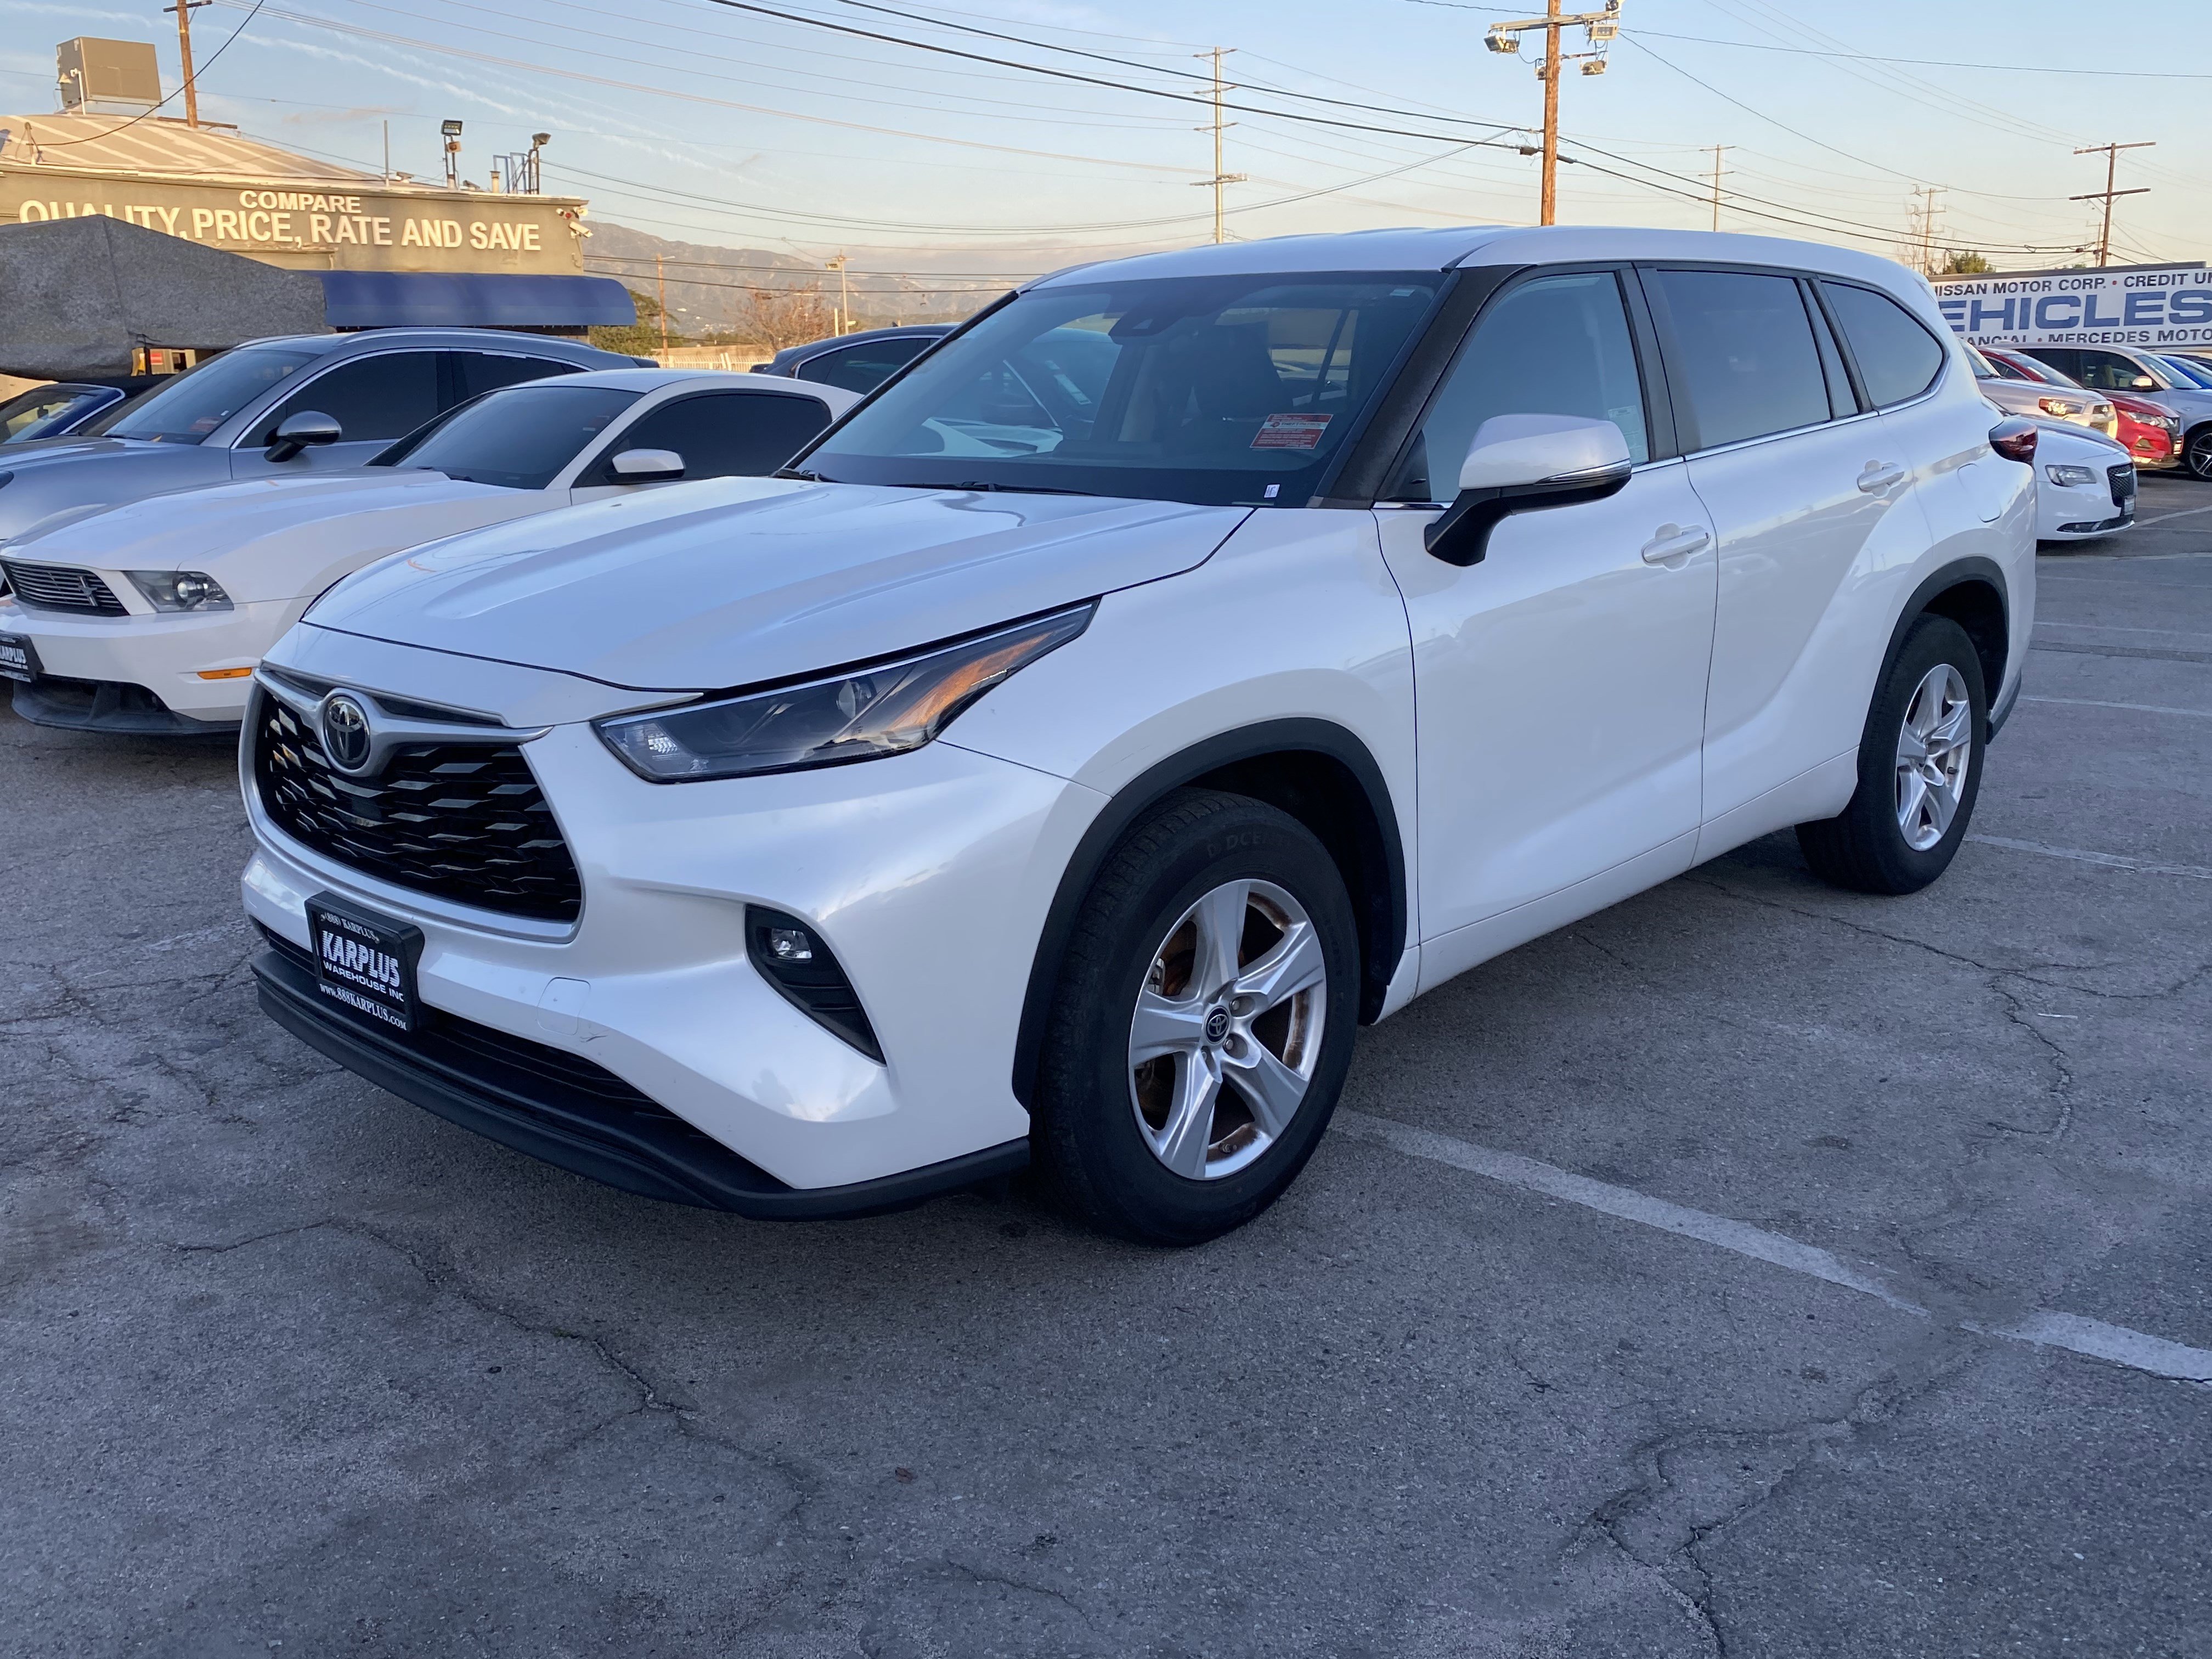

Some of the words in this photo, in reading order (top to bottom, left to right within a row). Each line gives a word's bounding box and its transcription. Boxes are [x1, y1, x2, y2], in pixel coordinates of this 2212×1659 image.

[239, 190, 362, 213] COMPARE
[192, 208, 302, 248] PRICE,
[309, 214, 393, 245] RATE
[401, 218, 463, 247] AND
[470, 222, 541, 251] SAVE
[1993, 280, 2052, 294] MOTOR
[2058, 278, 2106, 290] CORP.
[2124, 273, 2188, 287] CREDIT
[2049, 330, 2150, 343] MERCEDES
[322, 930, 400, 987] KARPLUS
[323, 960, 386, 994] WAREHOUSE
[389, 988, 404, 1002] INC
